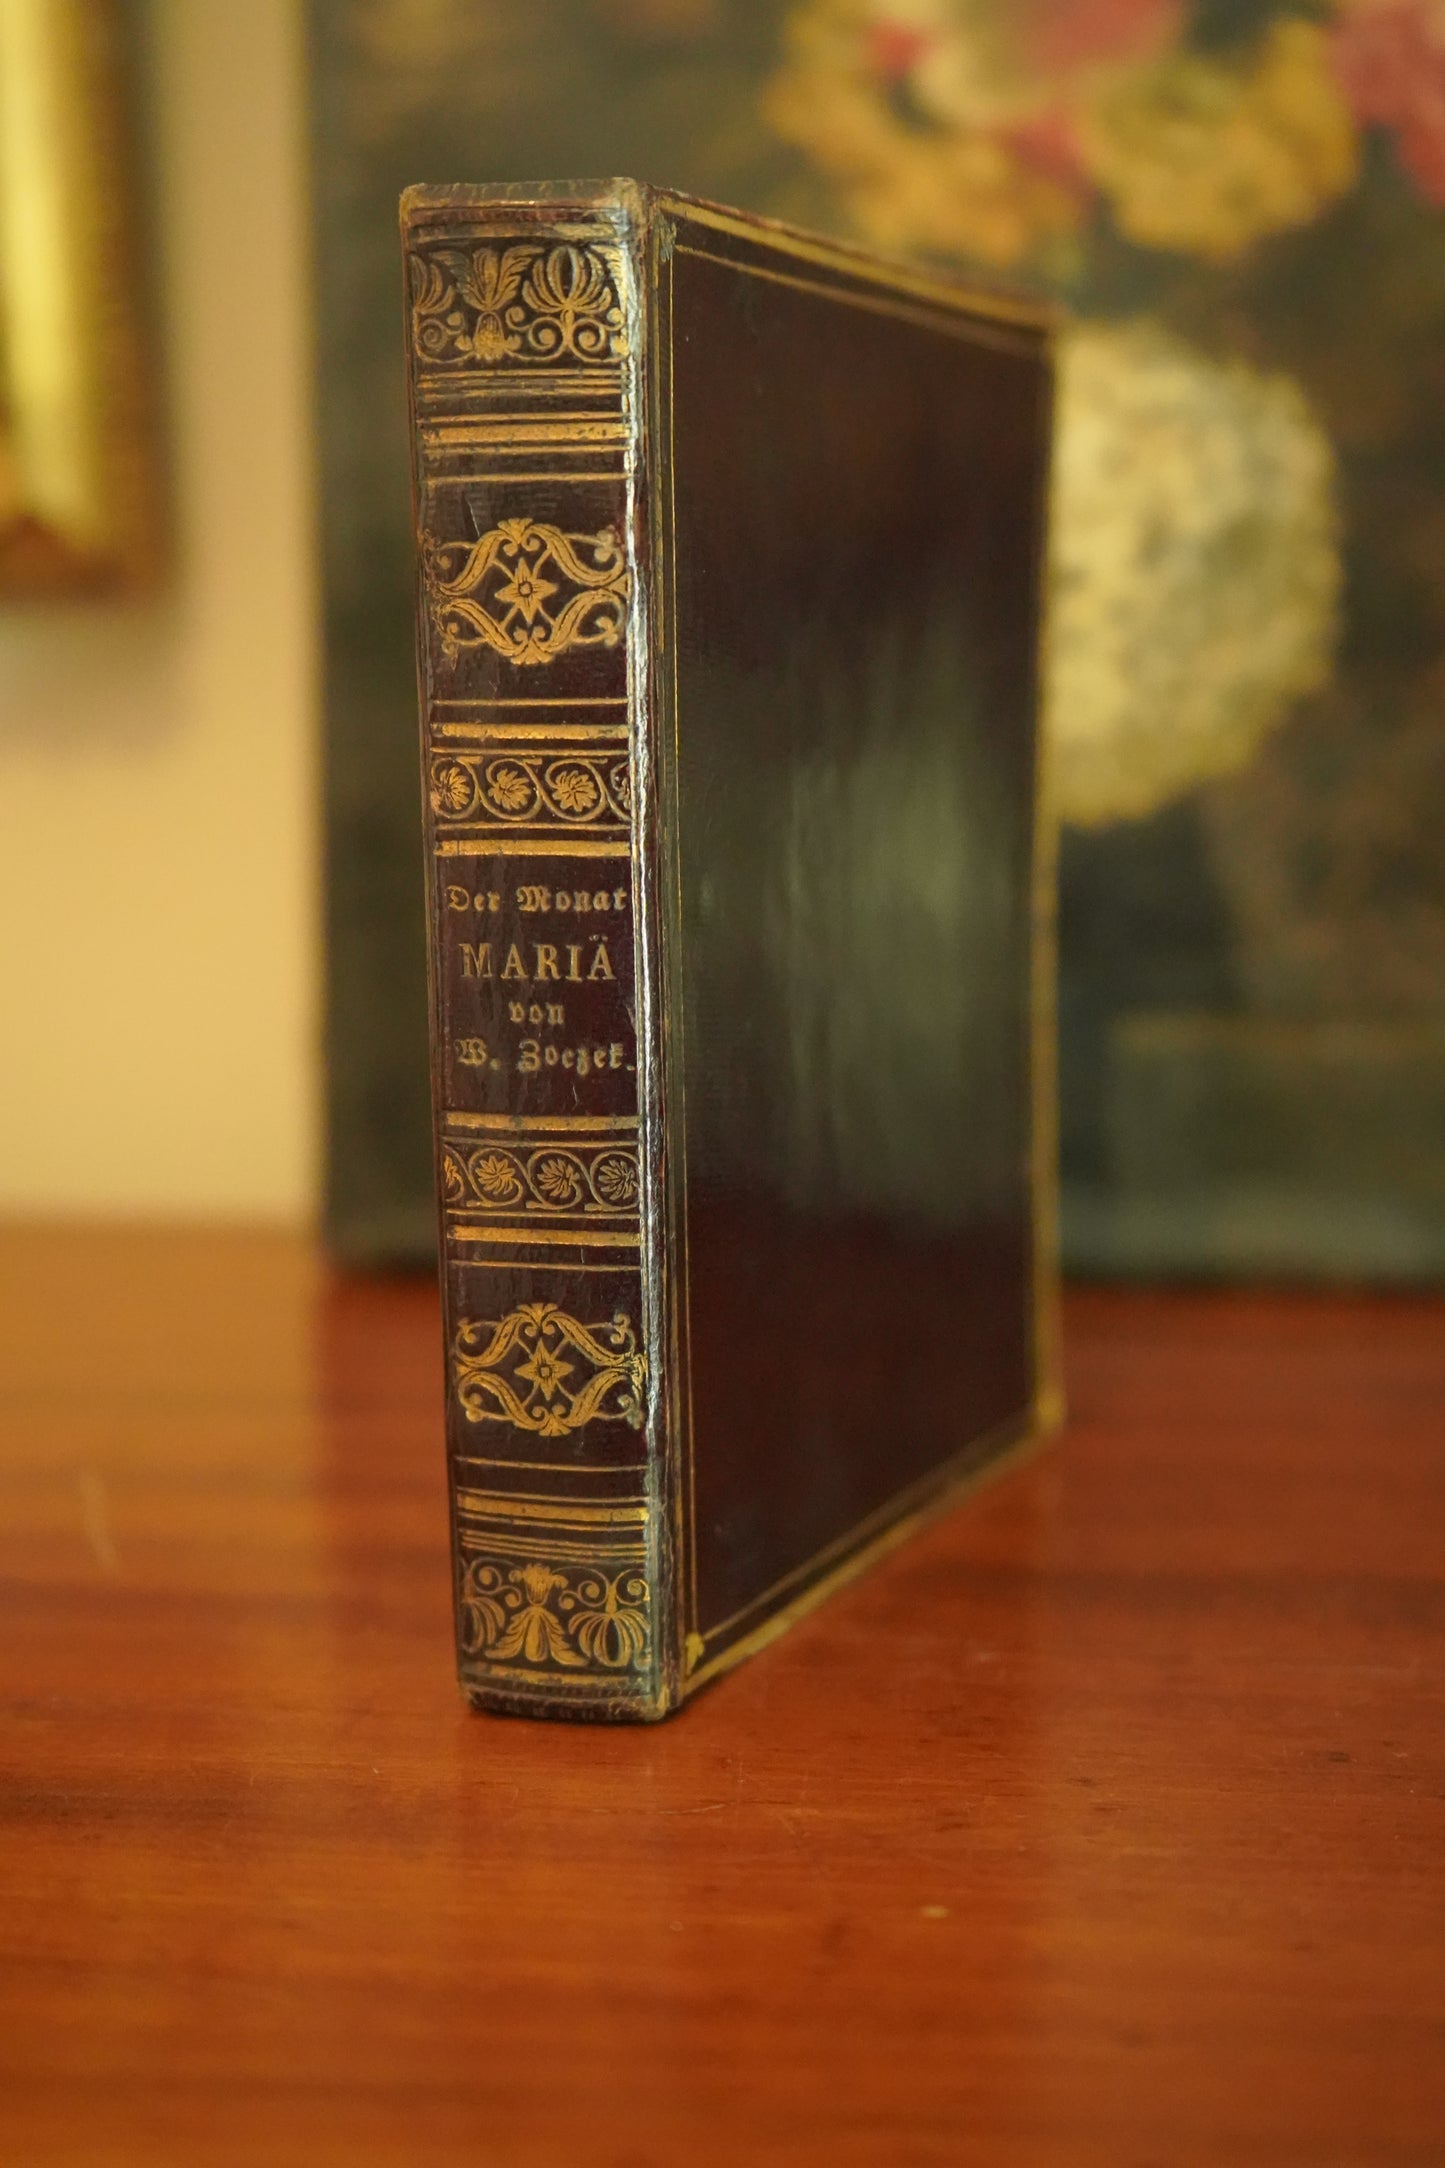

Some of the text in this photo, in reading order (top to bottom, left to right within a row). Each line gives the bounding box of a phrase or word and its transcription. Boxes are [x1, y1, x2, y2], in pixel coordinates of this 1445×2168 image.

[447, 884, 628, 913] Der Monat
[458, 933, 617, 983] MARIÄ
[508, 1001, 565, 1025] von
